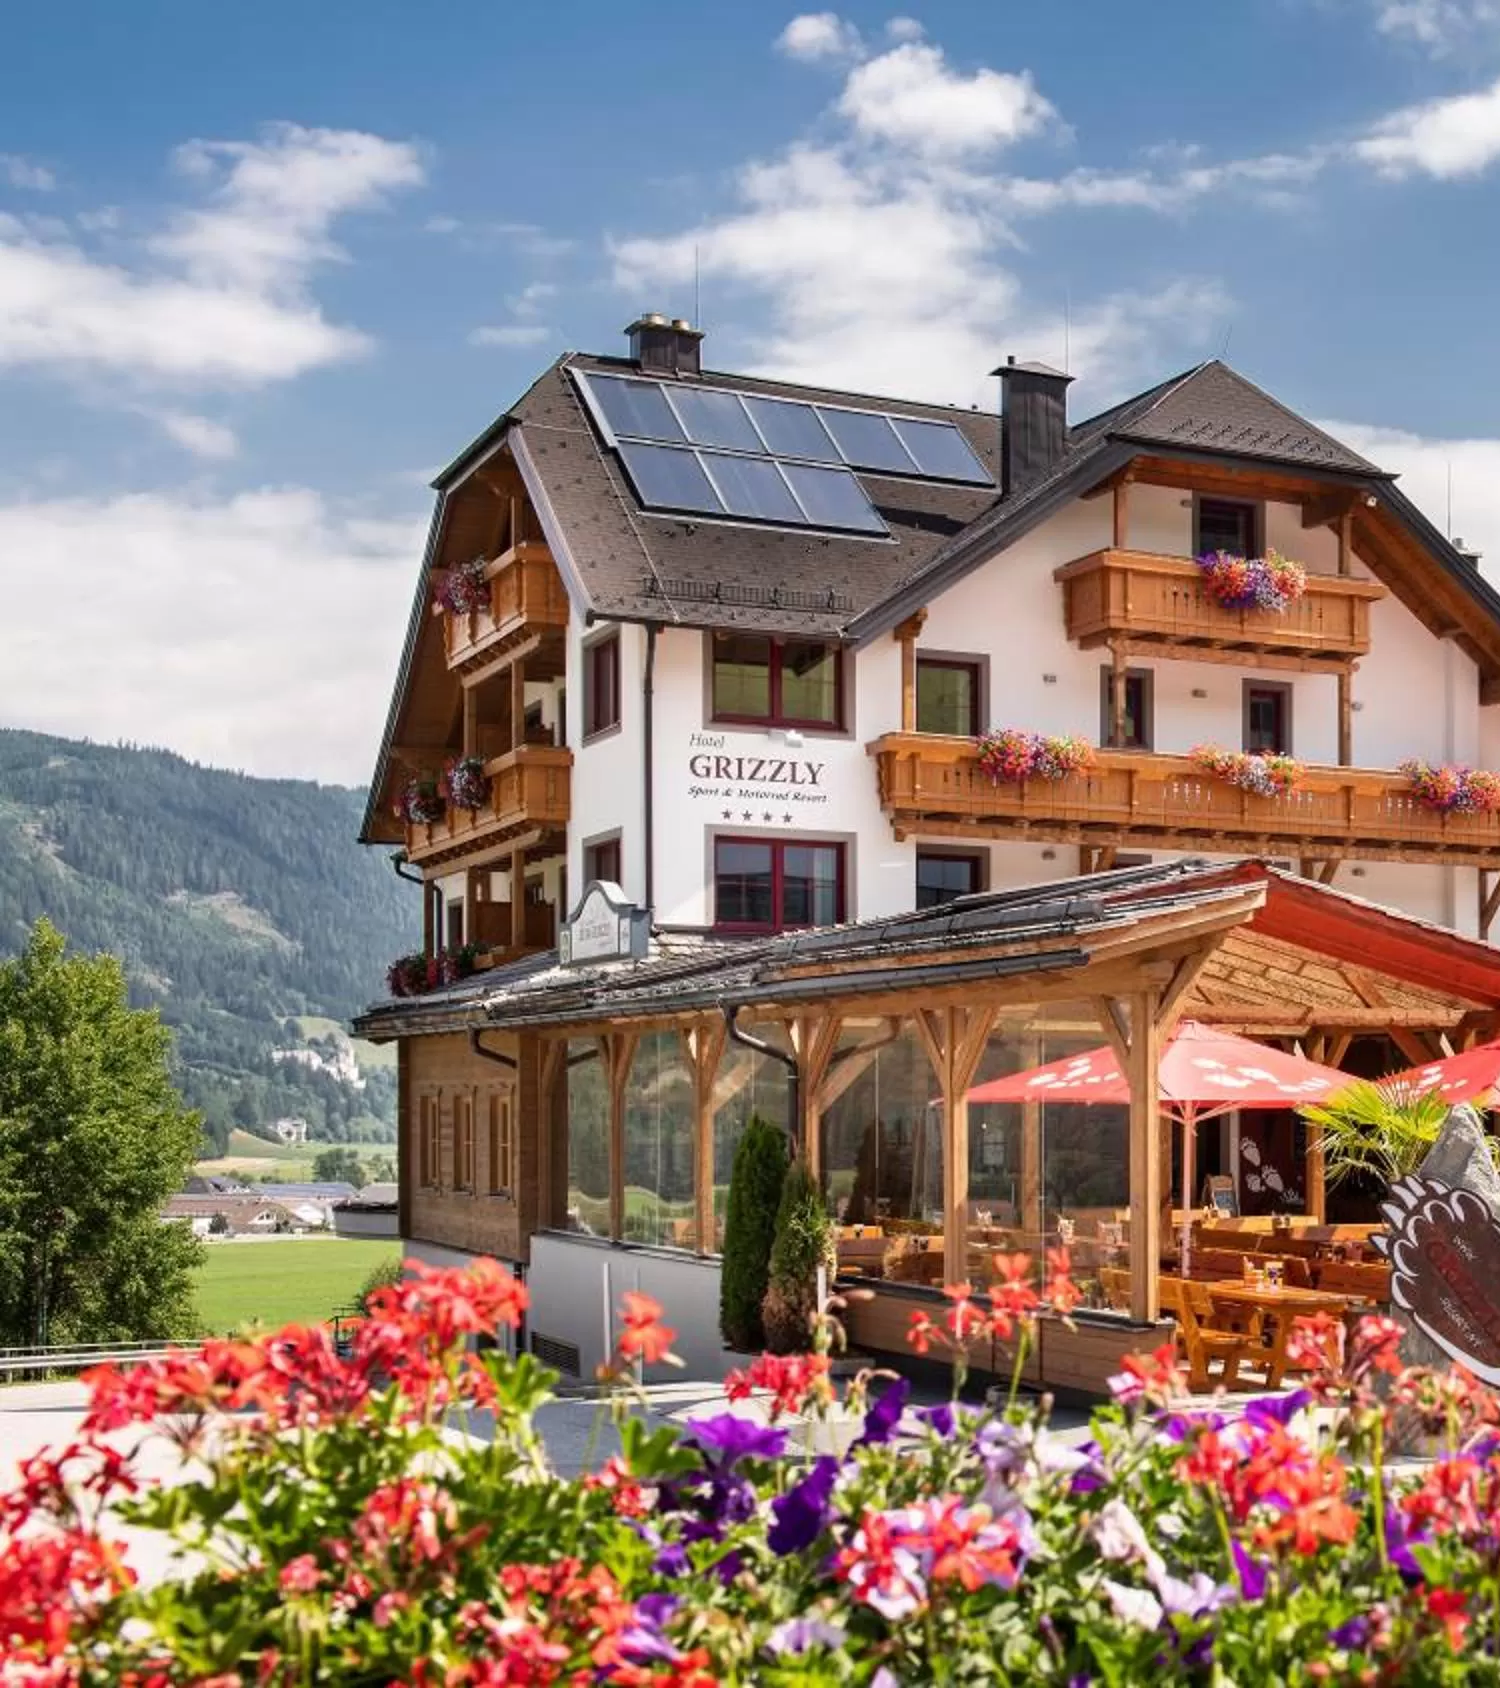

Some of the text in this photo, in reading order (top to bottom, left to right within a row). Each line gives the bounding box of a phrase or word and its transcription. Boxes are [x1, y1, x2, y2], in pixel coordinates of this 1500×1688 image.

[689, 733, 725, 749] Hotel
[689, 754, 825, 785] GRIZZLY
[688, 785, 719, 799] Sport
[721, 787, 732, 797] &
[791, 792, 828, 803] Resort
